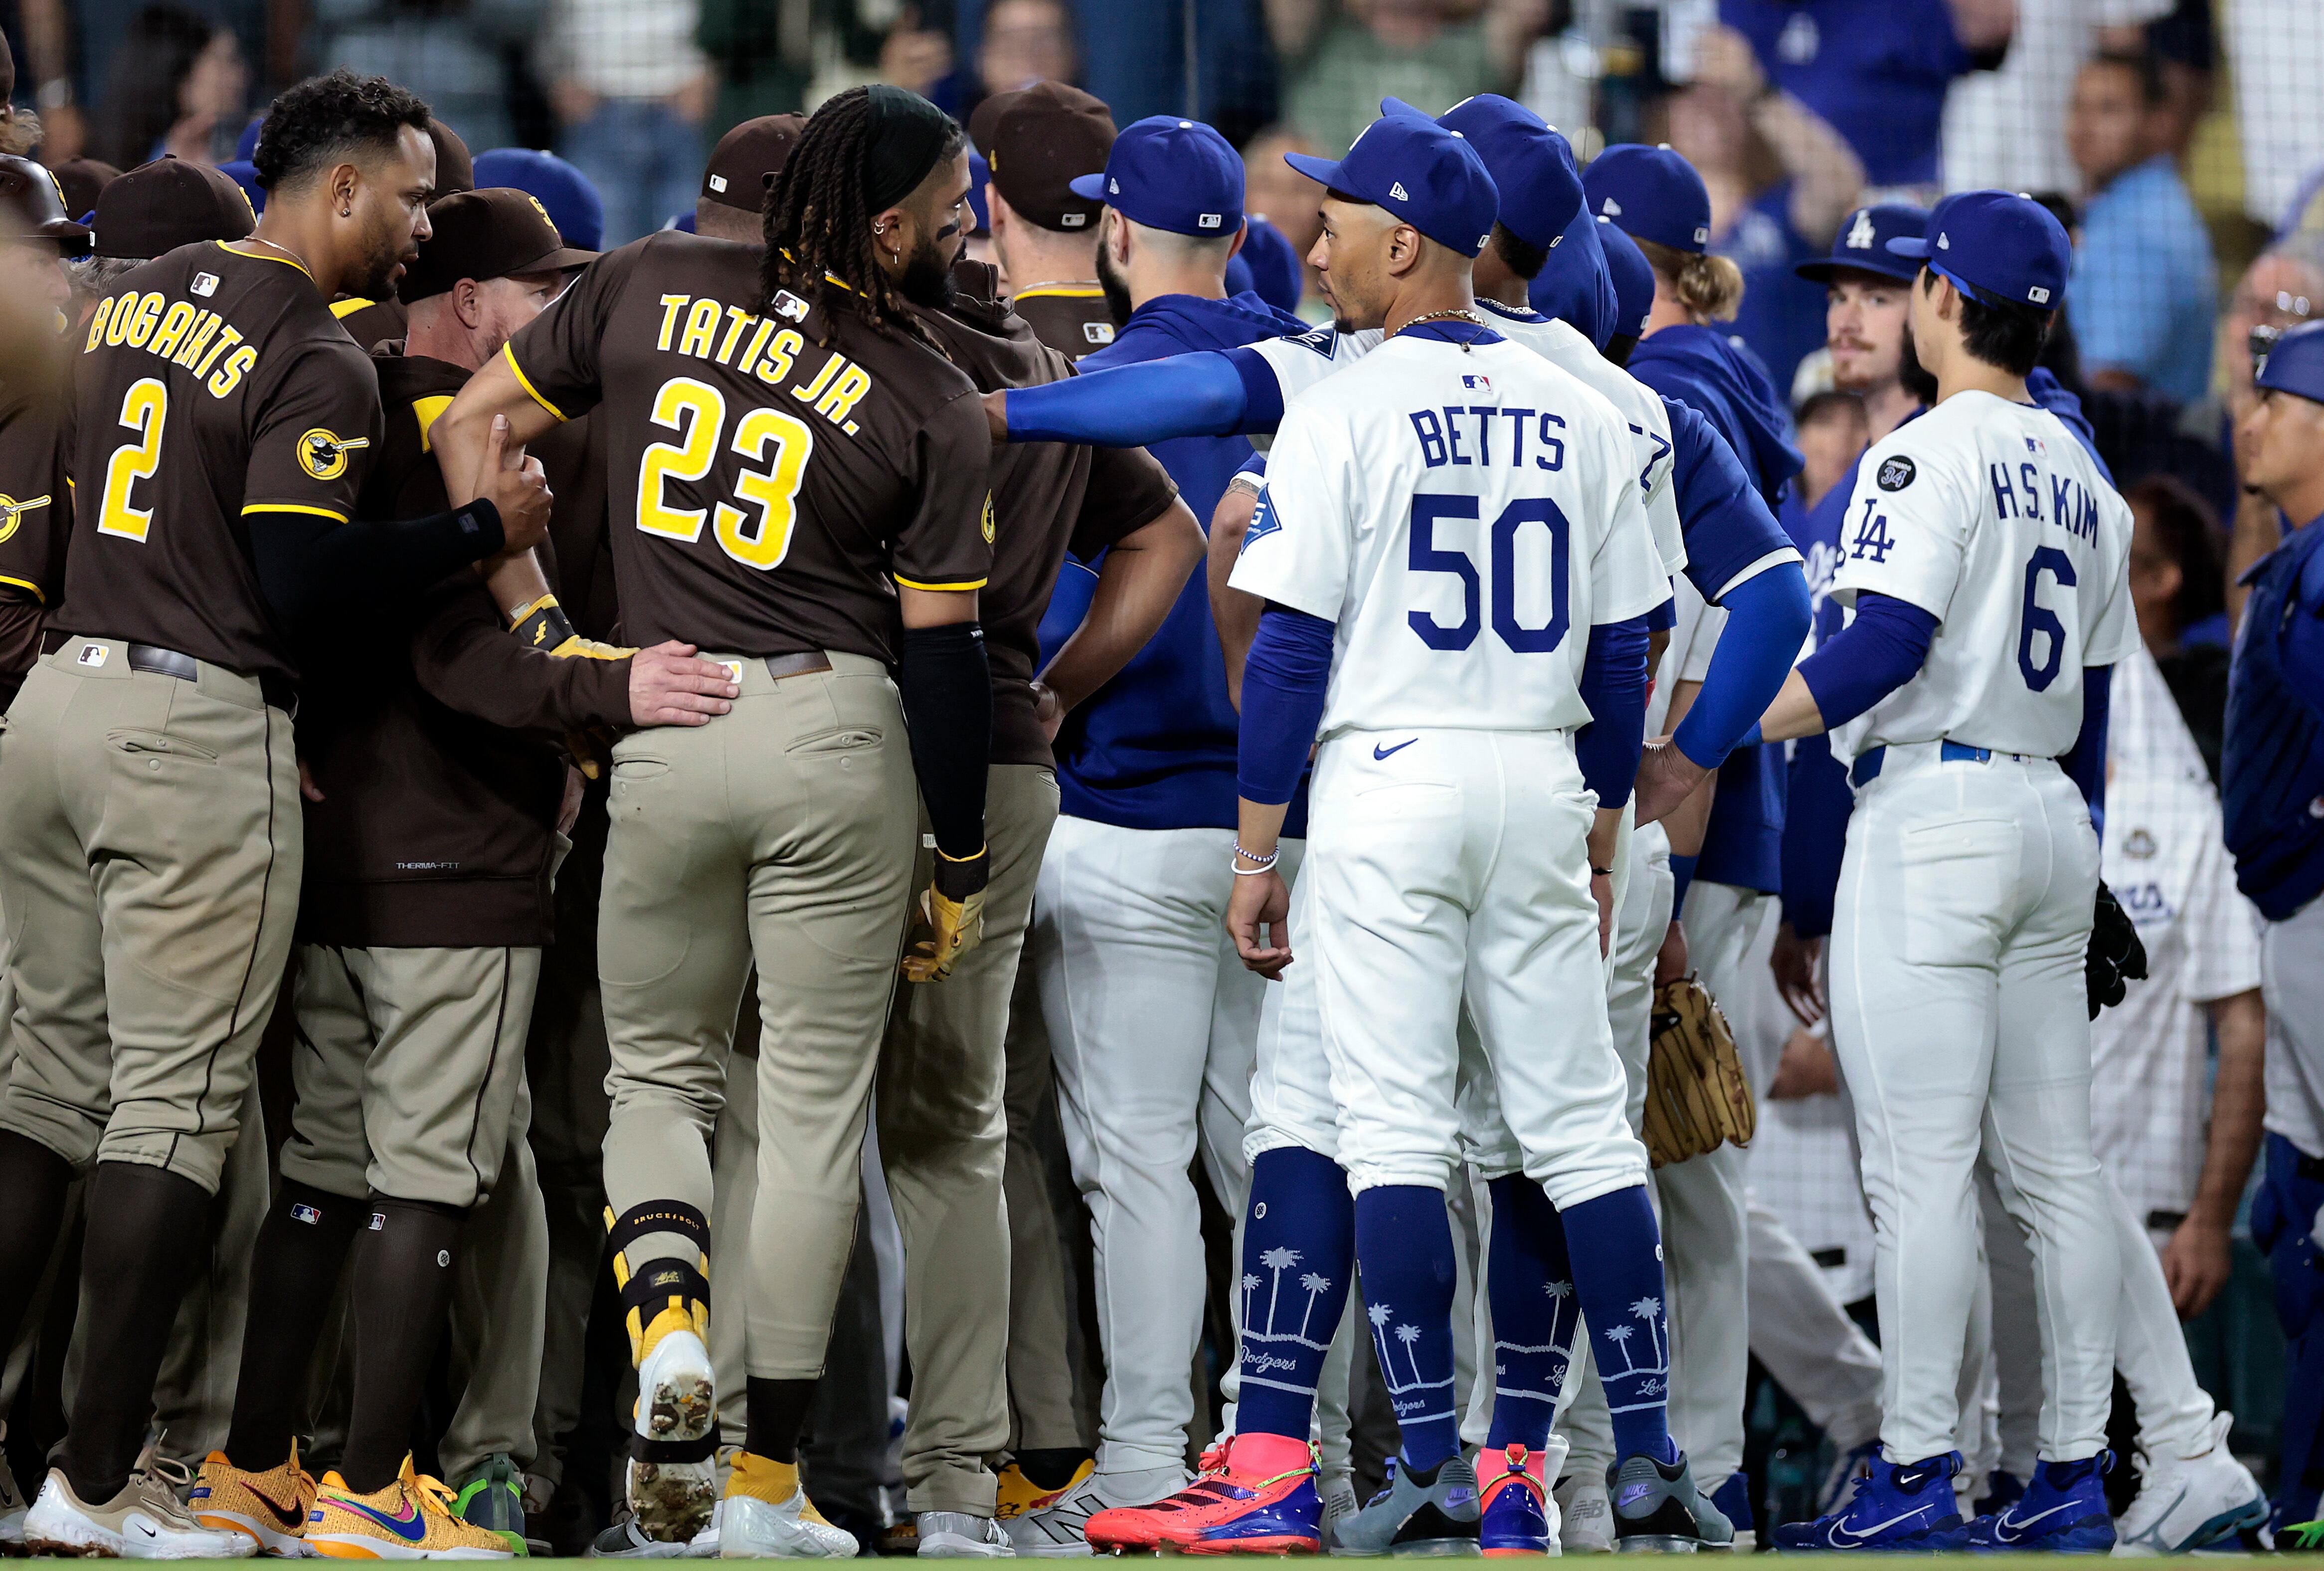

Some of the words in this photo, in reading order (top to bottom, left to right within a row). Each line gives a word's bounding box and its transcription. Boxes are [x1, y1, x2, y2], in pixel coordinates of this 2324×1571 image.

[1846, 209, 1876, 249] LA
[657, 293, 804, 385] TATIS
[790, 352, 872, 436] JR.
[97, 378, 168, 544] 2
[1409, 405, 1566, 472] BETTS
[636, 377, 813, 571] 23
[1880, 466, 1908, 488] 34
[1850, 499, 1895, 564] LA
[2051, 473, 2098, 549] KIM
[1408, 494, 1570, 653] 50
[2018, 545, 2077, 693] 6
[634, 1212, 671, 1225] BRUCE
[679, 1215, 701, 1230] BOLT
[1241, 1345, 1296, 1374] Dodgers
[1449, 1488, 1472, 1499] NIKE
[1624, 1484, 1649, 1496] NIKE
